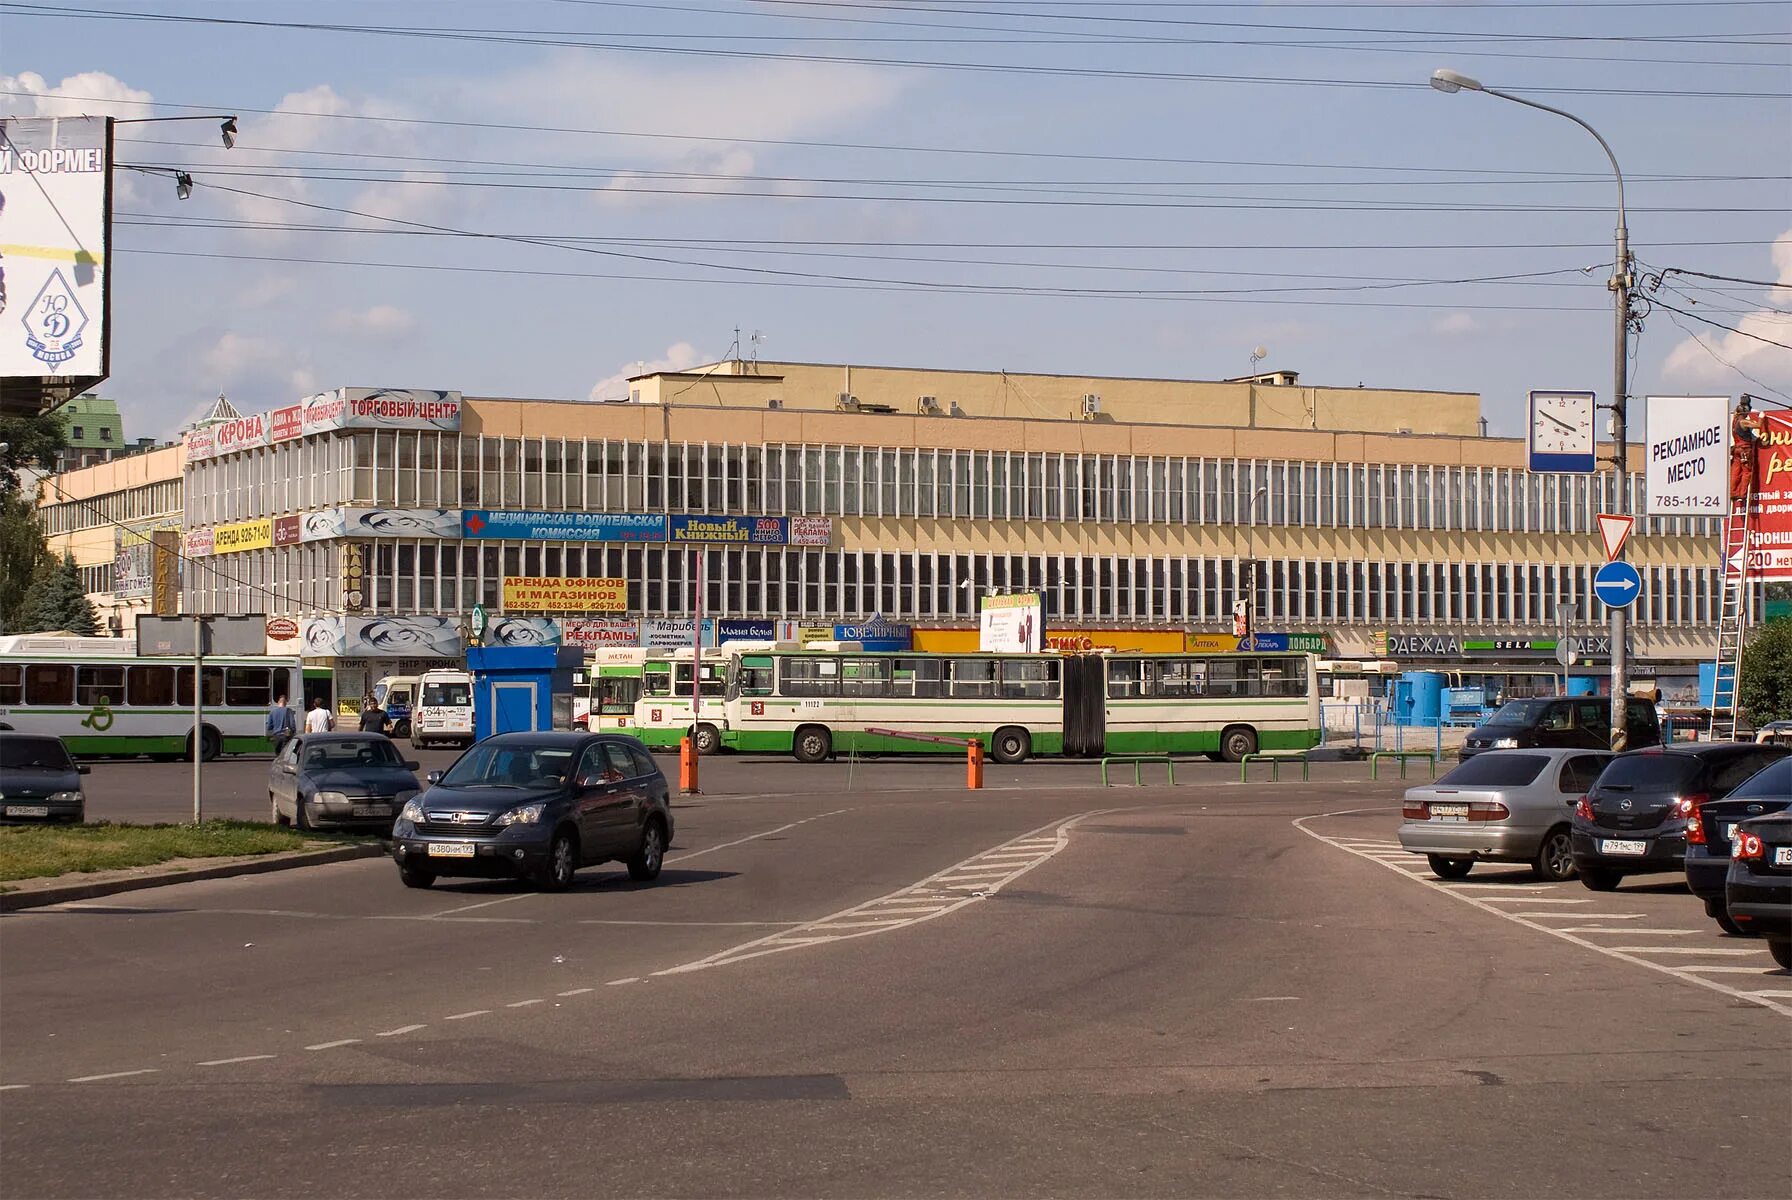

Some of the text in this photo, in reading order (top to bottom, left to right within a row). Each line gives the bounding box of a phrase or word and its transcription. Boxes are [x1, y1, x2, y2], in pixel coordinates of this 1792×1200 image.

[18, 148, 102, 173] ФОРМЕ!
[350, 398, 457, 421] ТОРГОВЫЙ ЦЕНТР
[221, 415, 263, 445] КРОНА
[1653, 425, 1720, 462] РЕКЛАМНОЕ
[1667, 456, 1706, 485] МЕСТО
[1655, 495, 1720, 507] 785-11-24
[488, 512, 663, 528] МЕДИЦИНСКАЯ ВОДИТЕЛЬСКАЯ
[756, 518, 779, 530] 500
[215, 529, 240, 547] АРЕНДА
[240, 525, 270, 543] 926-71-00
[531, 527, 600, 539] КОМИССИЯ
[1748, 552, 1772, 567] 200
[504, 578, 624, 588] АРЕНДА ОФИСОВ
[516, 590, 617, 600] И МАГАЗИНОВ
[504, 601, 540, 609] 452-55-27
[566, 631, 636, 640] РЕКЛАМЫ
[720, 626, 773, 637] Магия белья
[1288, 637, 1327, 651] ЛОМБАРД
[1388, 637, 1458, 654] ОДЕЖДА
[1495, 641, 1531, 649] SELA
